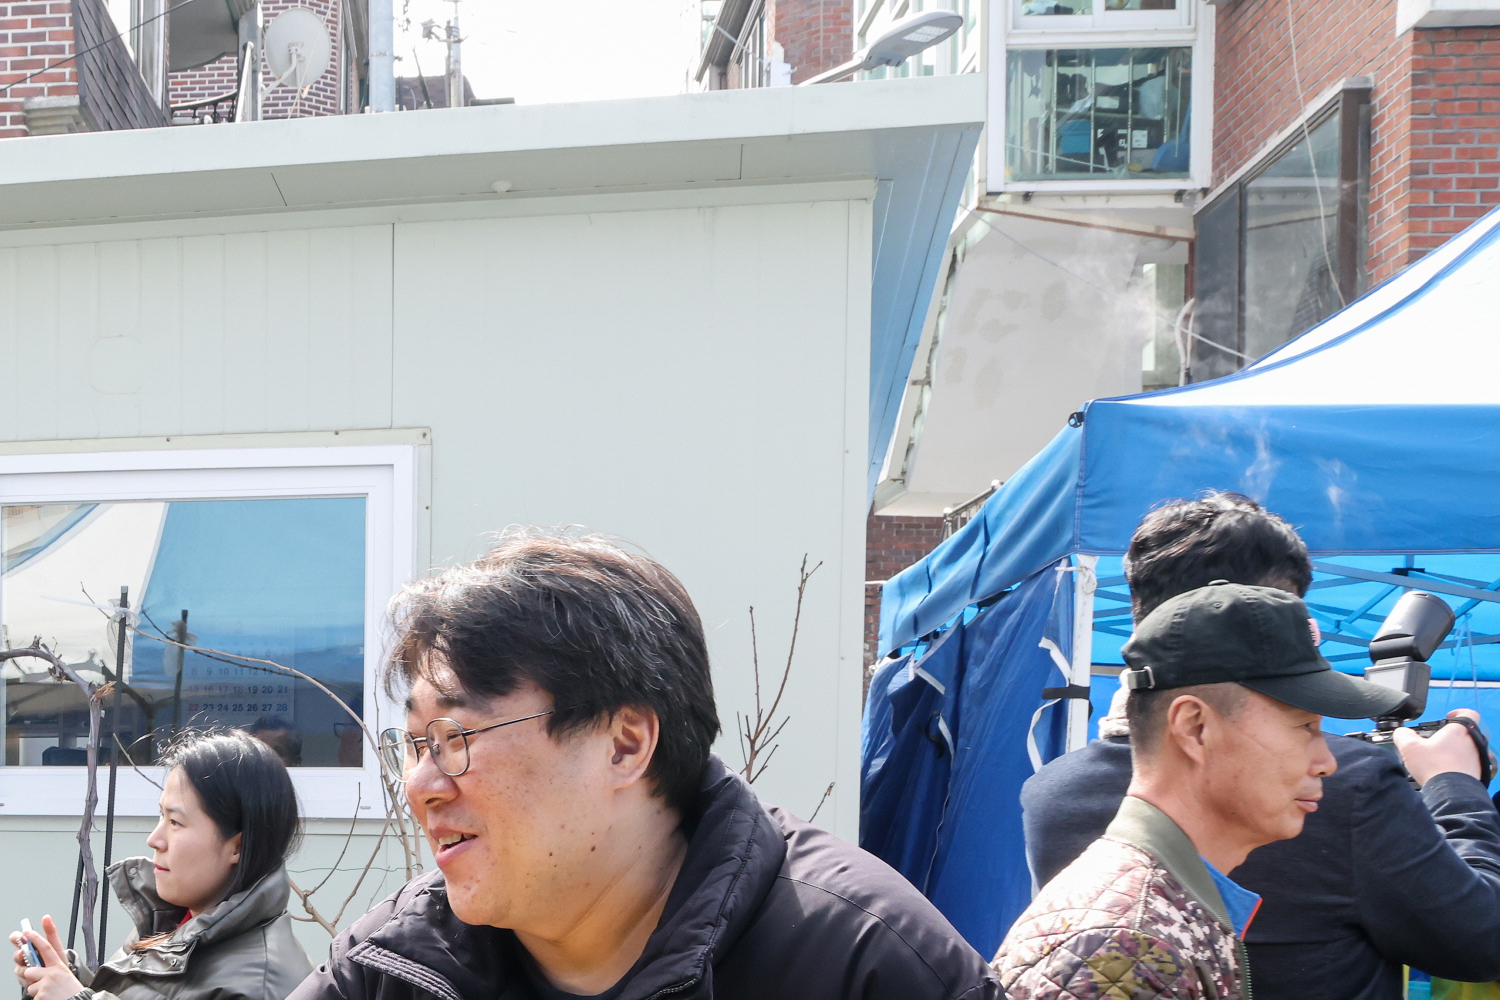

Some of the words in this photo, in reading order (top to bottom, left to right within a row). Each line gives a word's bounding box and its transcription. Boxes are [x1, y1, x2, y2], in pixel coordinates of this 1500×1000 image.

[219, 685, 229, 694] 17
[248, 685, 258, 694] 19
[261, 685, 273, 694] 20
[277, 685, 288, 694] 21
[188, 703, 199, 712] 22
[203, 703, 214, 712] 23
[217, 703, 229, 712] 24
[232, 703, 243, 712] 25
[247, 703, 258, 712] 26
[261, 703, 273, 712] 27
[276, 703, 288, 712] 28
